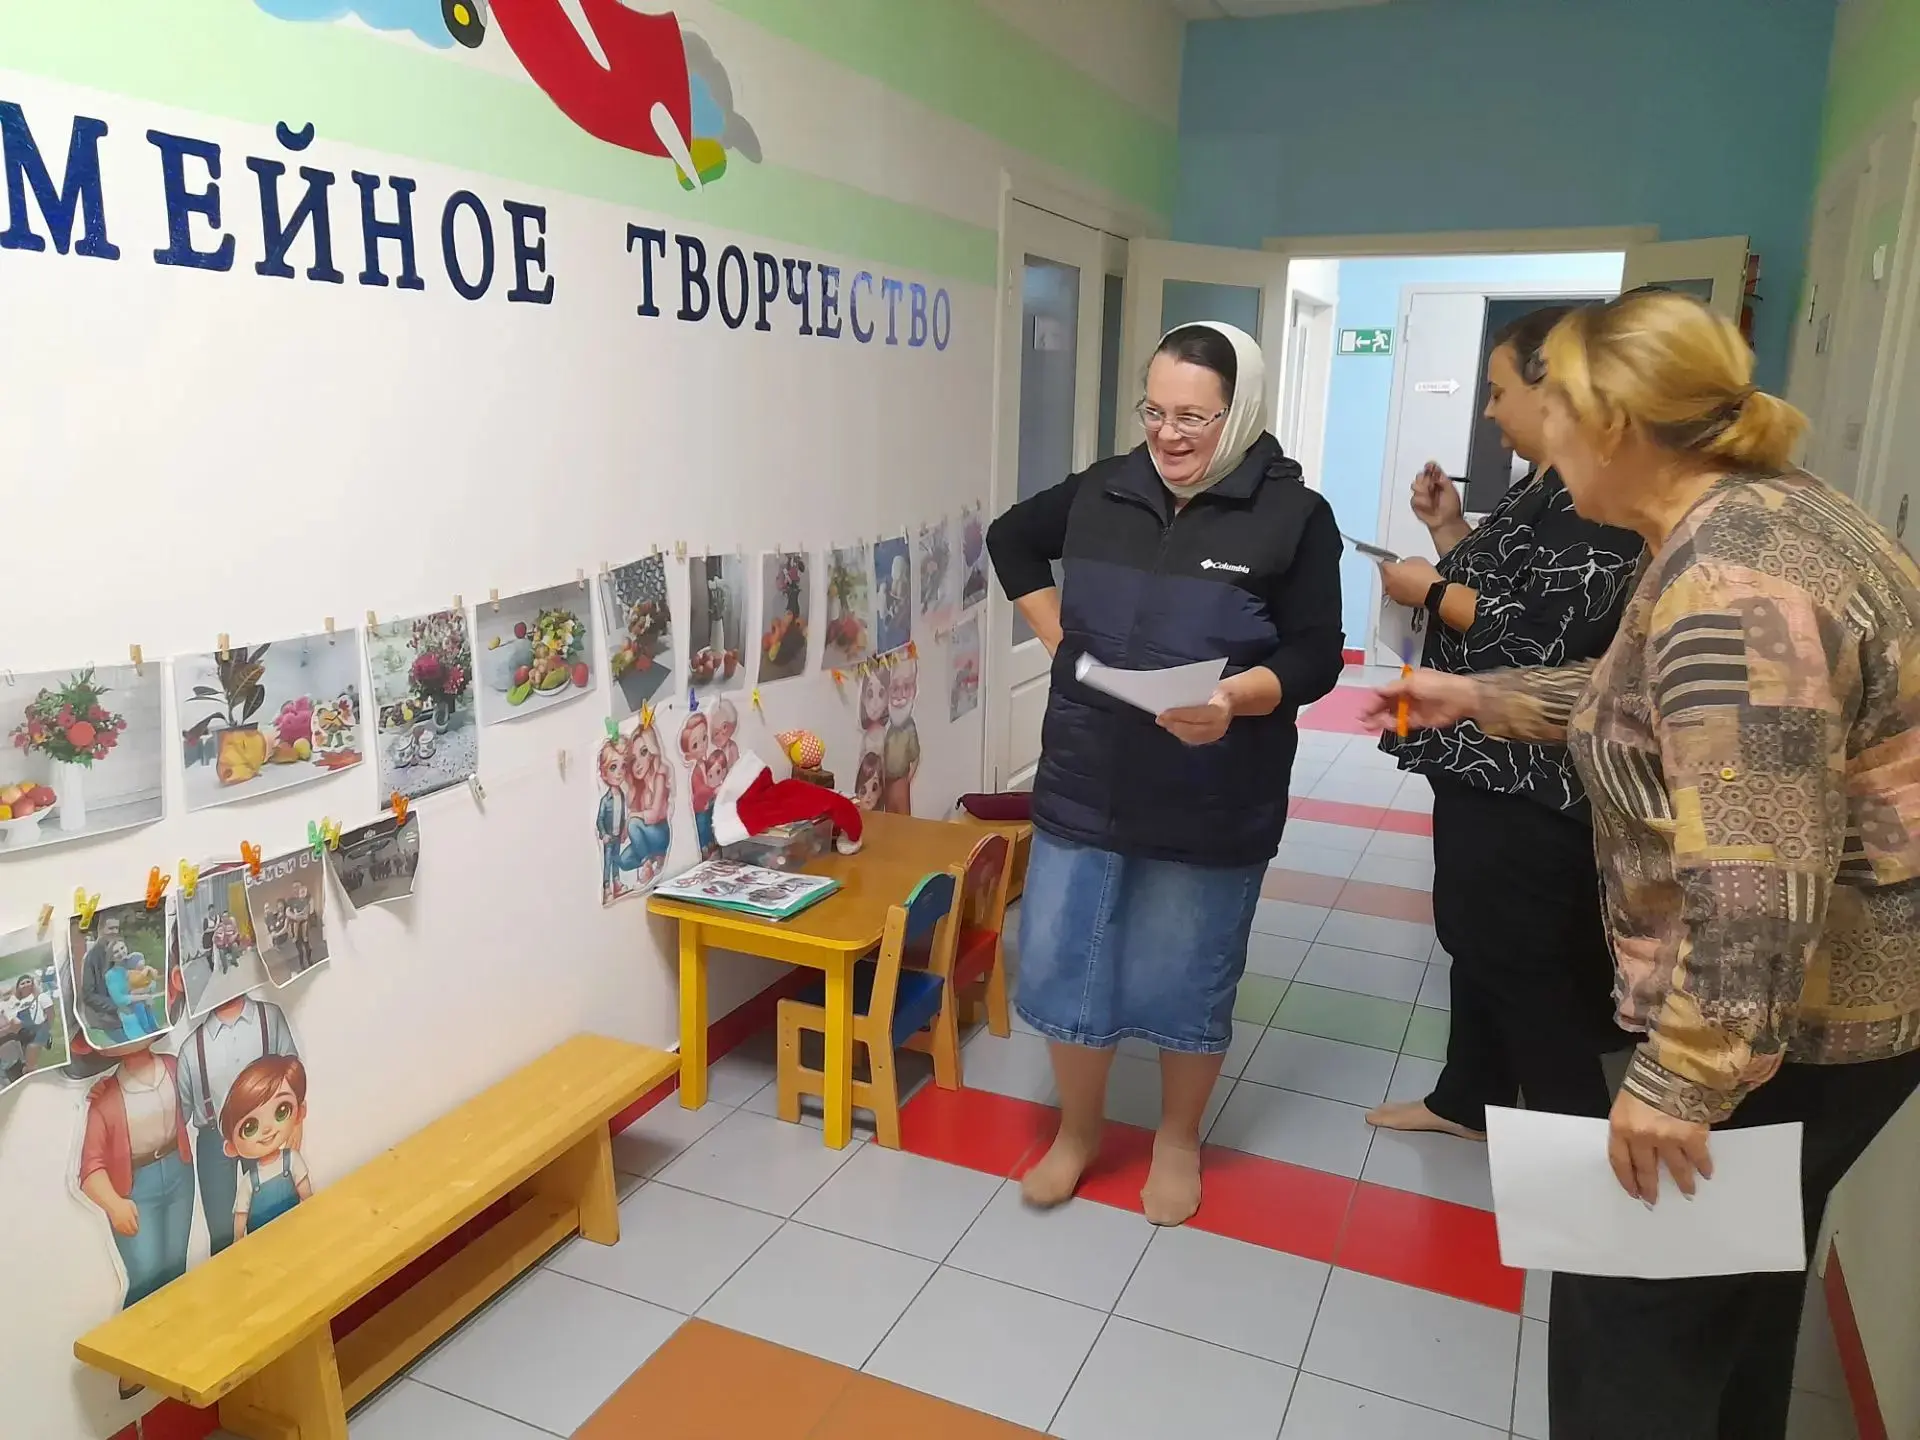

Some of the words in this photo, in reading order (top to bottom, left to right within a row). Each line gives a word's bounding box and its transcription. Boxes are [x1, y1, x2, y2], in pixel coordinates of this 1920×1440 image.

[0, 101, 555, 304] МЕЙНОЕ
[626, 222, 951, 351] ТВОРЧЕСТВО
[1212, 561, 1250, 574] Columbia
